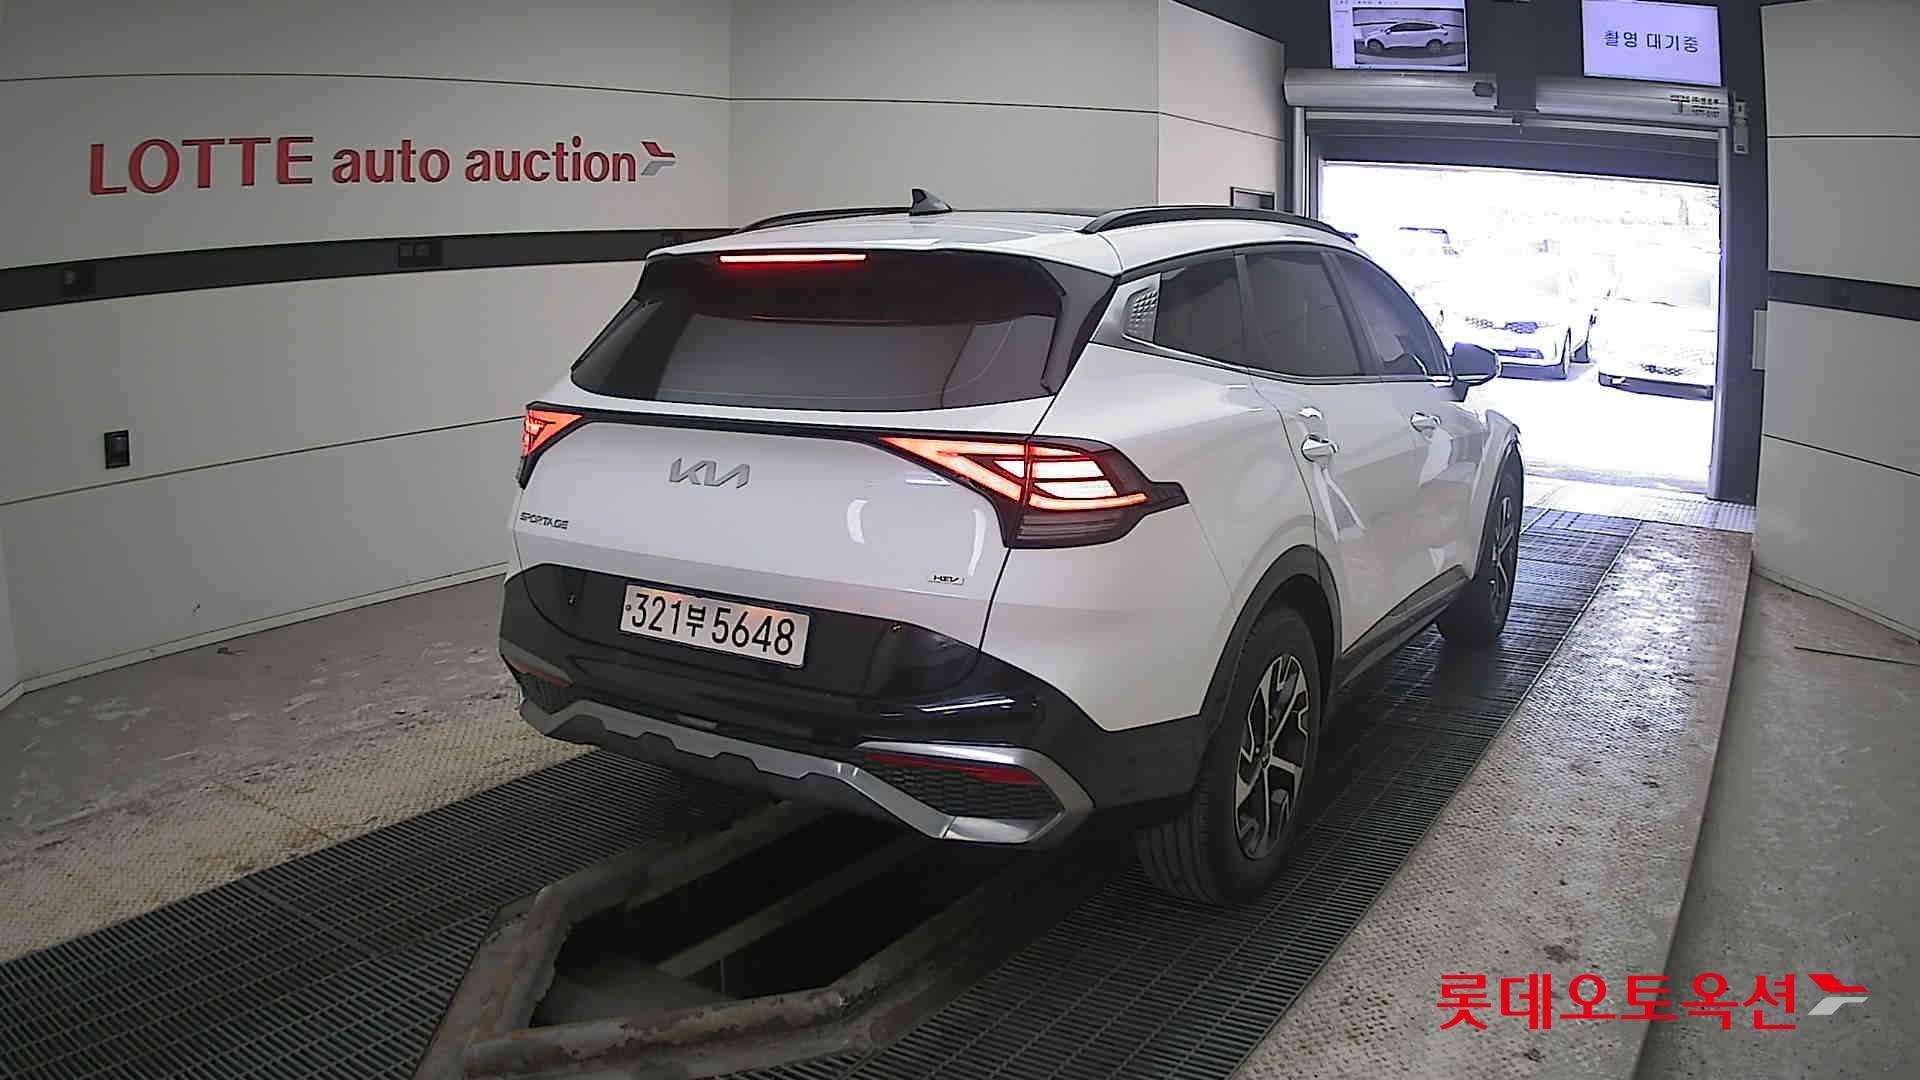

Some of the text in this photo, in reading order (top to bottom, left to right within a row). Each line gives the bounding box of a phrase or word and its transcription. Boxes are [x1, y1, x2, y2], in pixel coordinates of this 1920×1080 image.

[1646, 32, 1699, 53] 대기중
[90, 135, 637, 196] LOTTE auto auction
[669, 457, 750, 489] KIA
[519, 511, 569, 530] SPORTAGE
